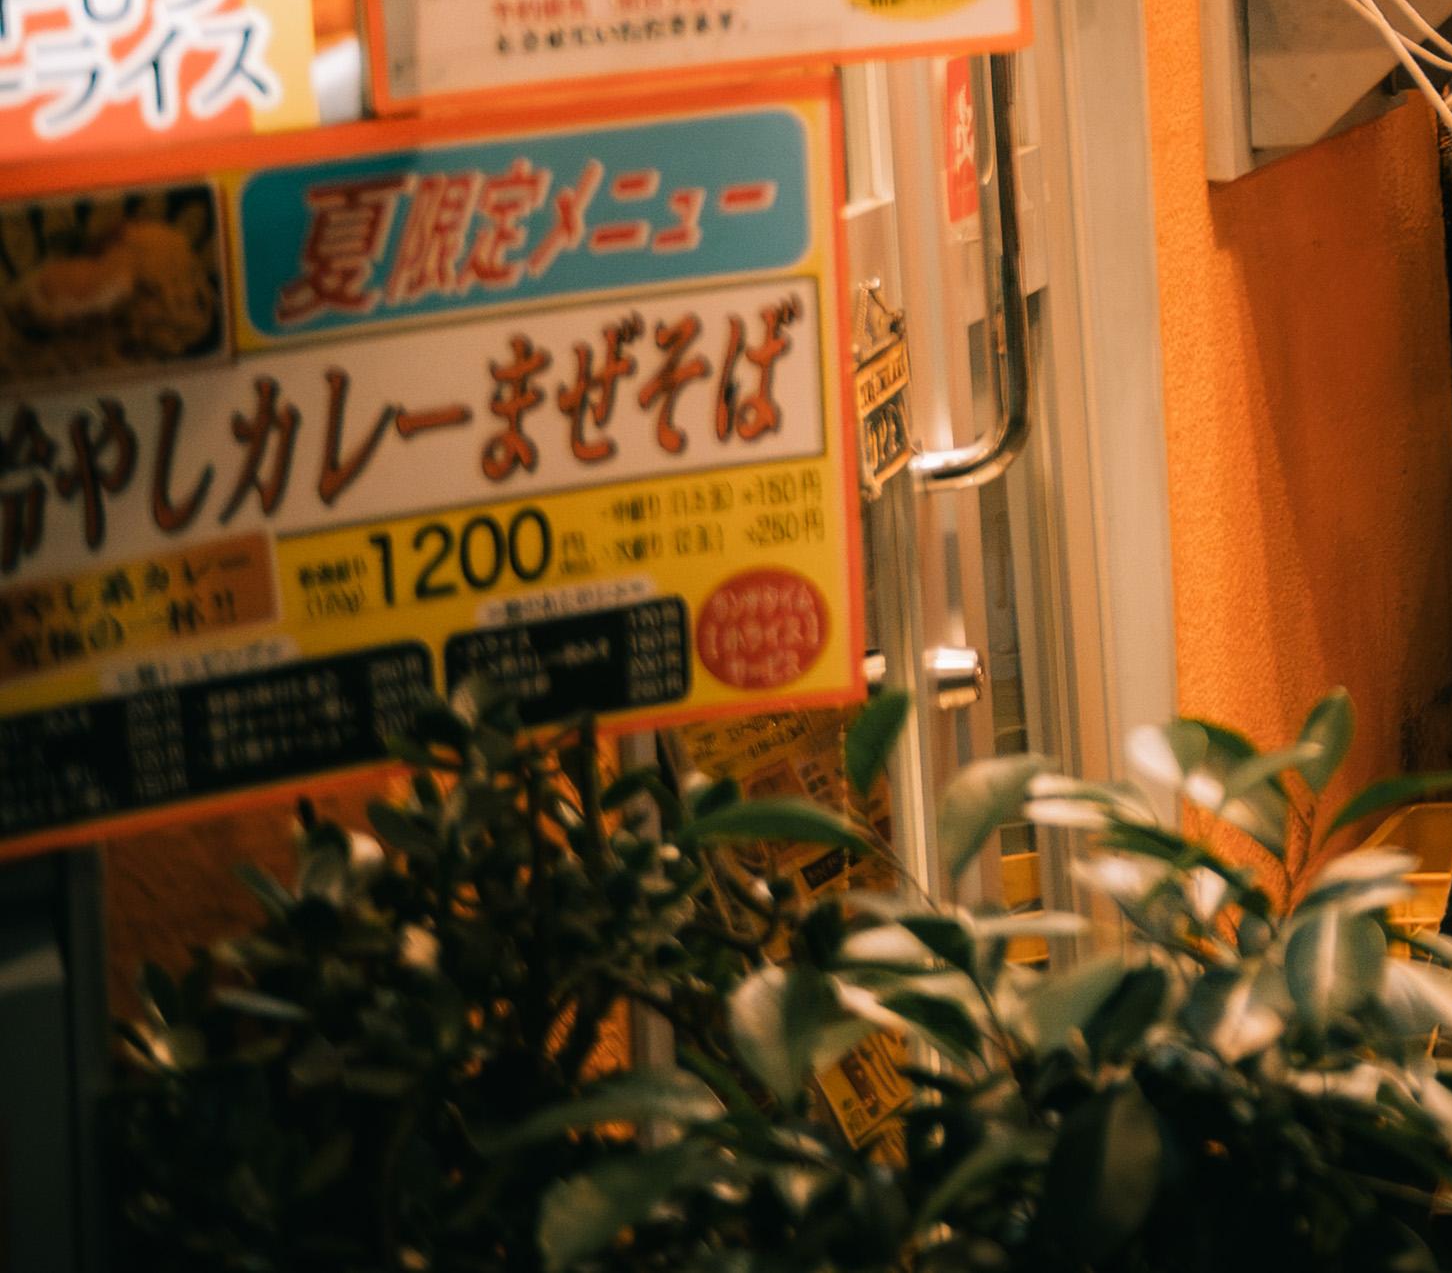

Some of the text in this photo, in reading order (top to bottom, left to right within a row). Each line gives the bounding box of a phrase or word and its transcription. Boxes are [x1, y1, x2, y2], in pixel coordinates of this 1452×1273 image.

[278, 159, 778, 327] 夏限定メニュー
[368, 508, 554, 609] 1200
